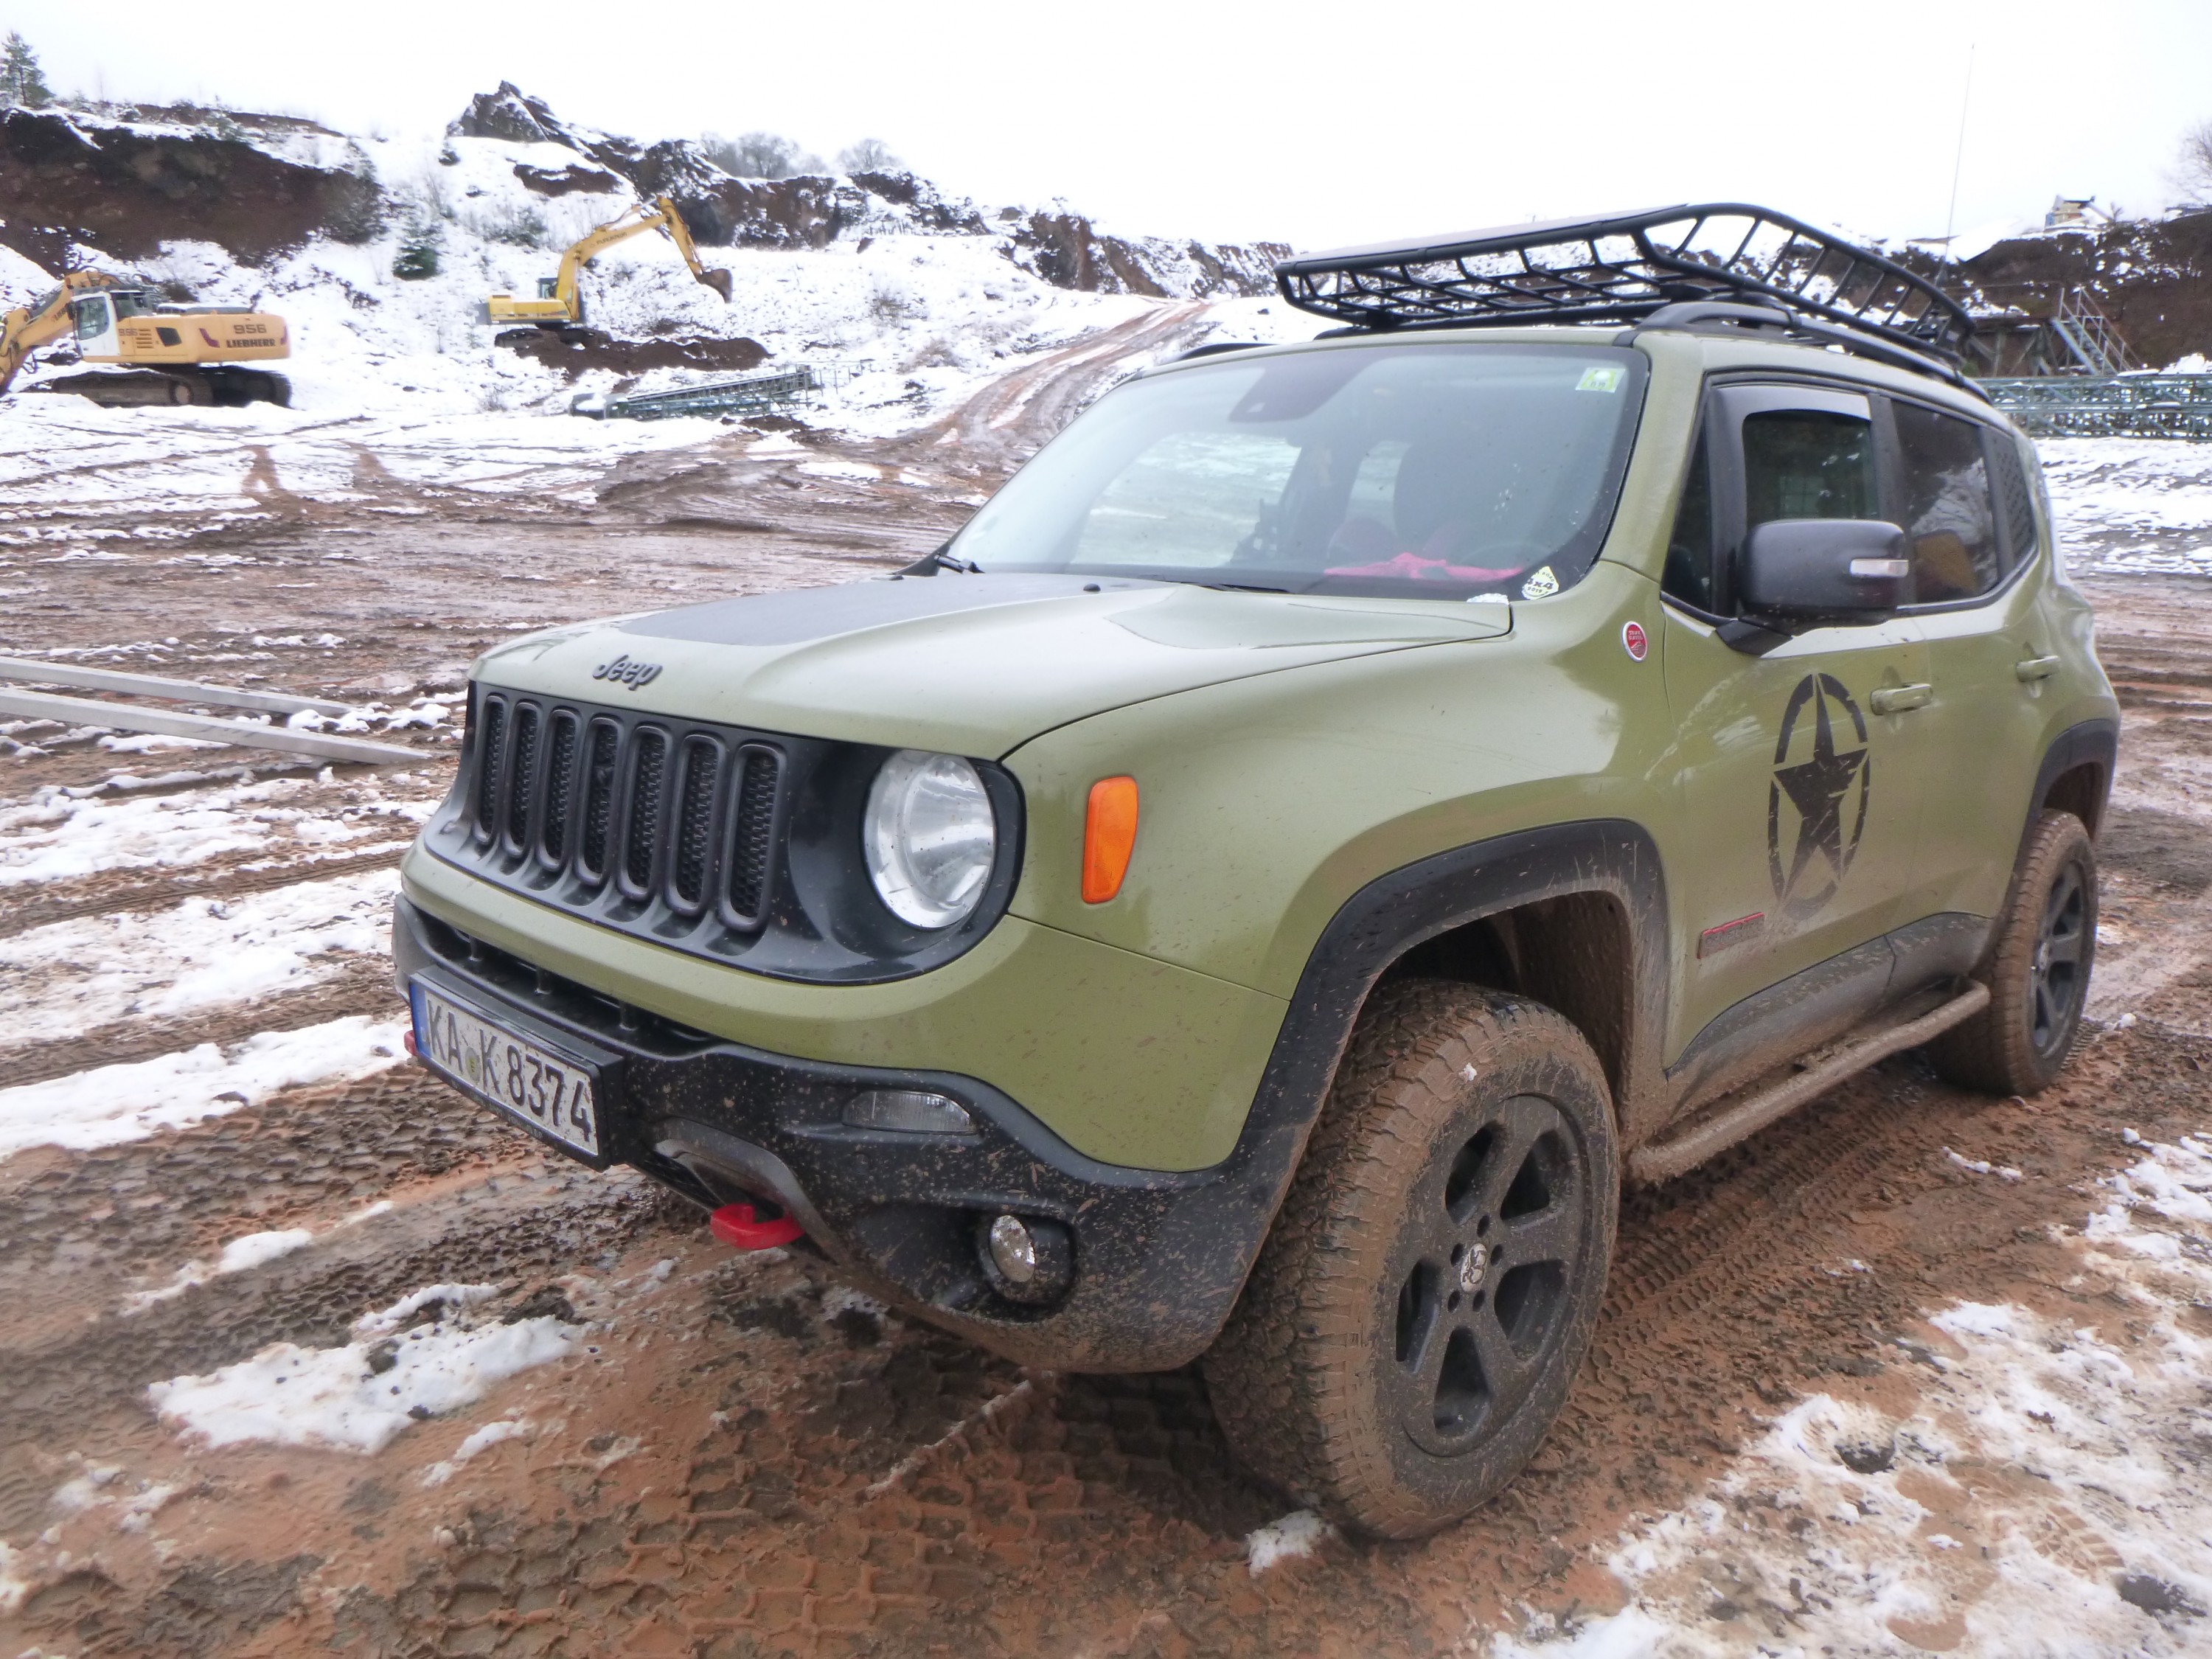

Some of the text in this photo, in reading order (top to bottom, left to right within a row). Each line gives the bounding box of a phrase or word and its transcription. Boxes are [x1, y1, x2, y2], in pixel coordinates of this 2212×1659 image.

[233, 324, 267, 334] 956
[226, 339, 276, 348] LIEBHERR
[593, 655, 663, 691] Jeep
[428, 999, 463, 1072] KA
